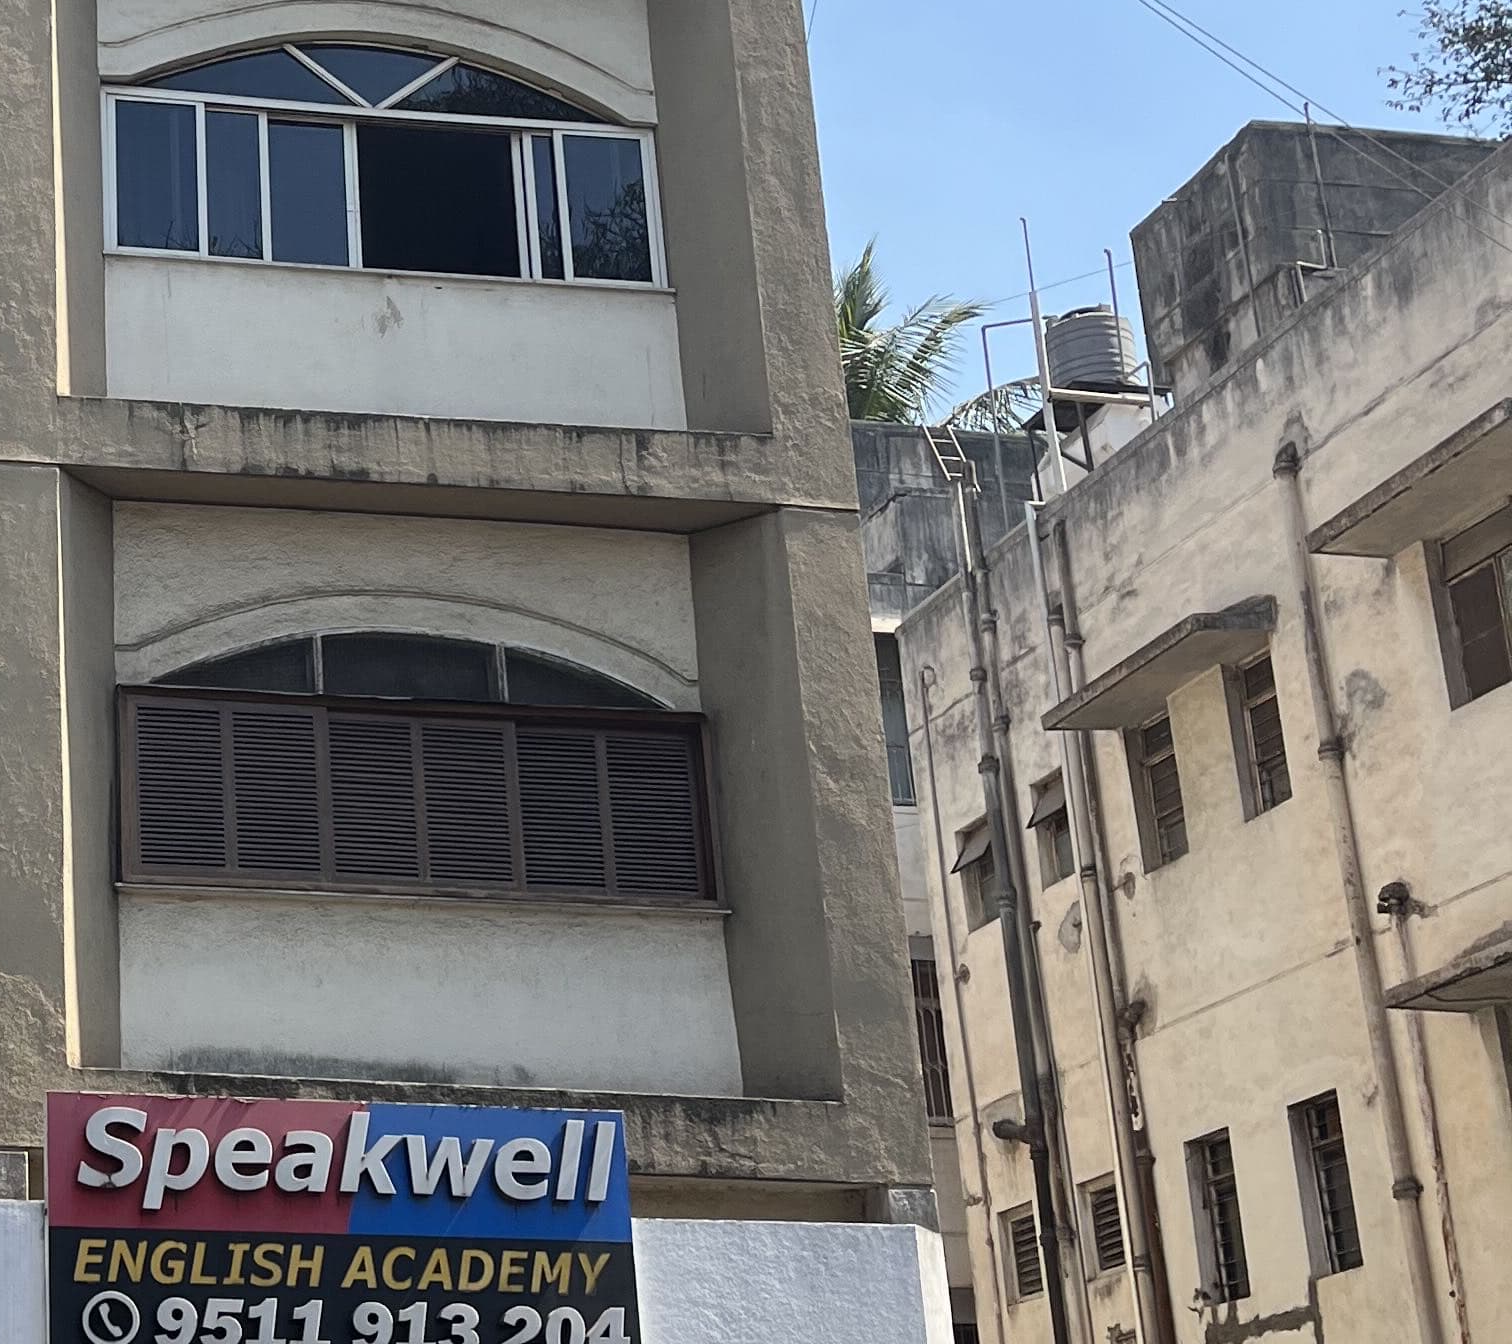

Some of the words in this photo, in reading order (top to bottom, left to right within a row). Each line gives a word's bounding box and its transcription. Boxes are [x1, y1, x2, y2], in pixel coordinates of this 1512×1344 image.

[77, 1106, 616, 1210] Speakwell
[73, 1238, 325, 1288] ENGLISH
[341, 1245, 610, 1296] ACADEMY
